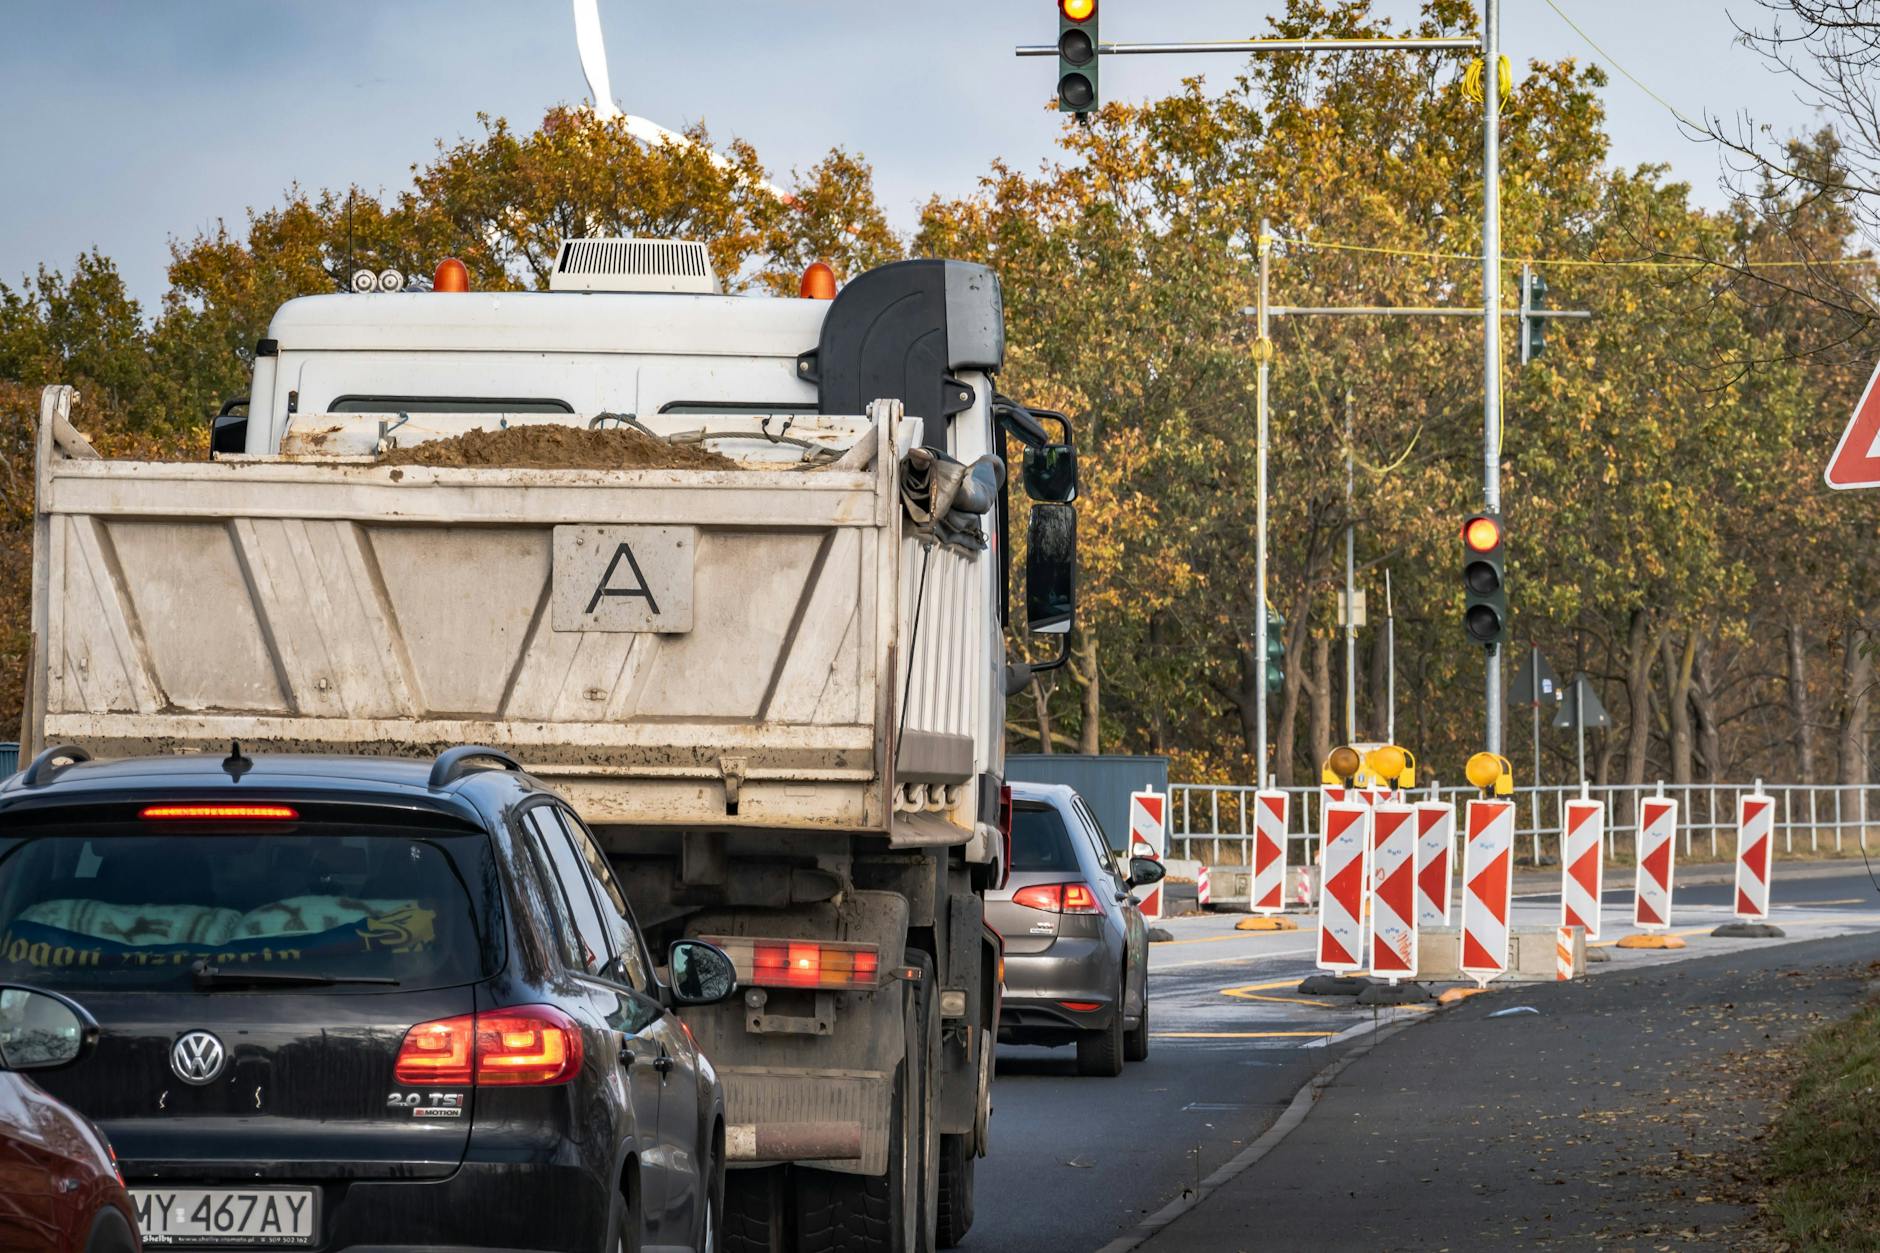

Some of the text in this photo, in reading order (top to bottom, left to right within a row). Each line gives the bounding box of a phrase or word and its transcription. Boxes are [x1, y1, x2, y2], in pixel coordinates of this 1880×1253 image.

[585, 543, 660, 615] A
[387, 1092, 421, 1106] 2.0
[142, 1235, 173, 1244] Shelby
